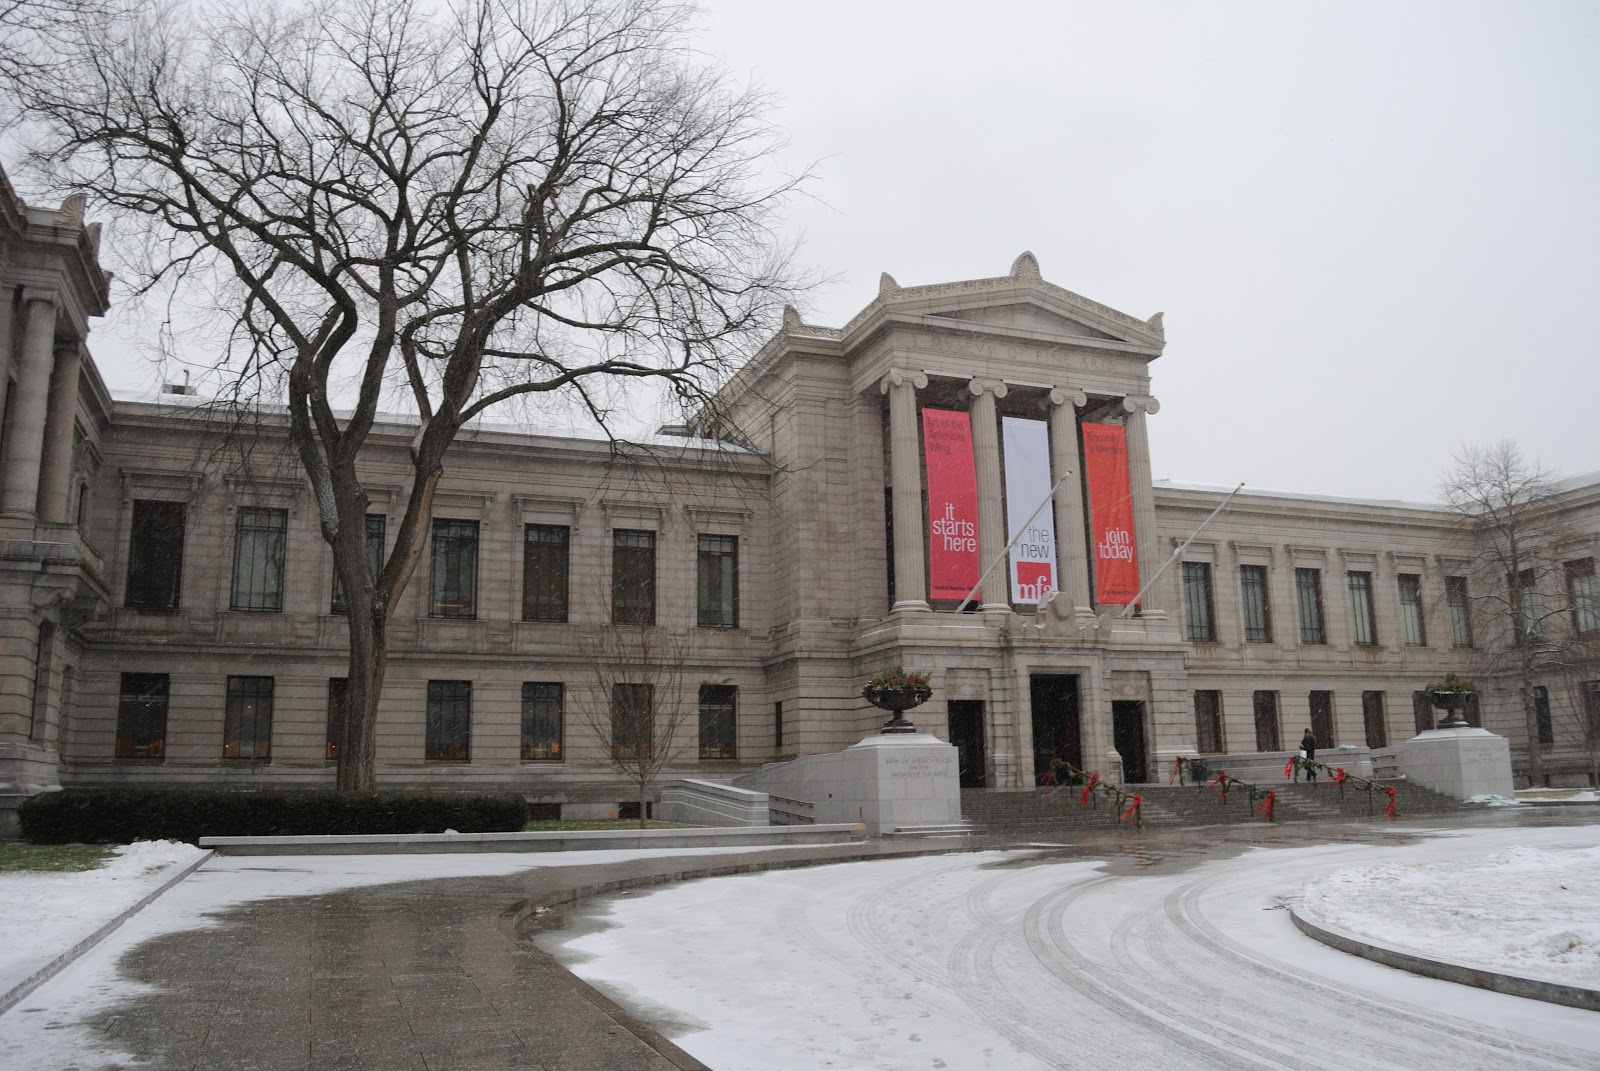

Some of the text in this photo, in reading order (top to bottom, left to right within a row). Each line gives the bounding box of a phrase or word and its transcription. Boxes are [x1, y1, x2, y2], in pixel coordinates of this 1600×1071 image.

[1007, 347, 1024, 359] OF
[1036, 350, 1072, 367] FINE
[1080, 357, 1117, 371] ARTS
[945, 502, 955, 521] it
[932, 517, 975, 537] starts
[1028, 525, 1049, 543] the
[1105, 527, 1129, 547] join
[944, 533, 977, 553] here
[1021, 543, 1050, 558] new
[1098, 541, 1134, 563] today
